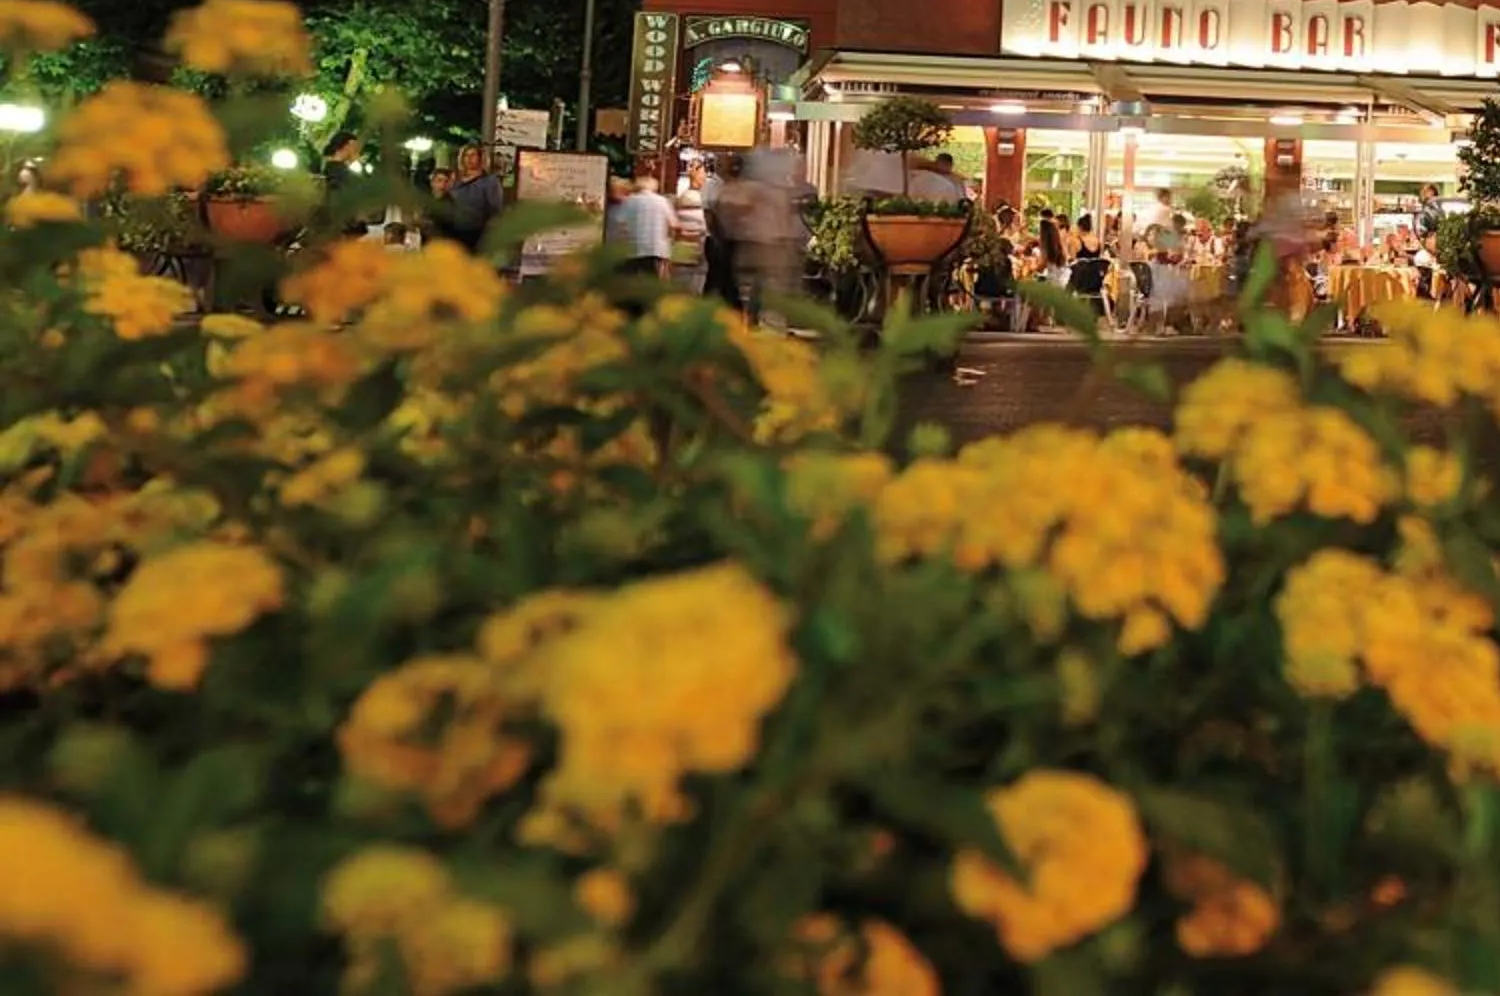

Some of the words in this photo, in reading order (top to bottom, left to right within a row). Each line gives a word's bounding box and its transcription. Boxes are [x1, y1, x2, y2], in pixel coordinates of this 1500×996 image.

[643, 15, 669, 73] WOOD
[1049, 1, 1220, 50] FAUNO
[1272, 12, 1366, 57] BAR
